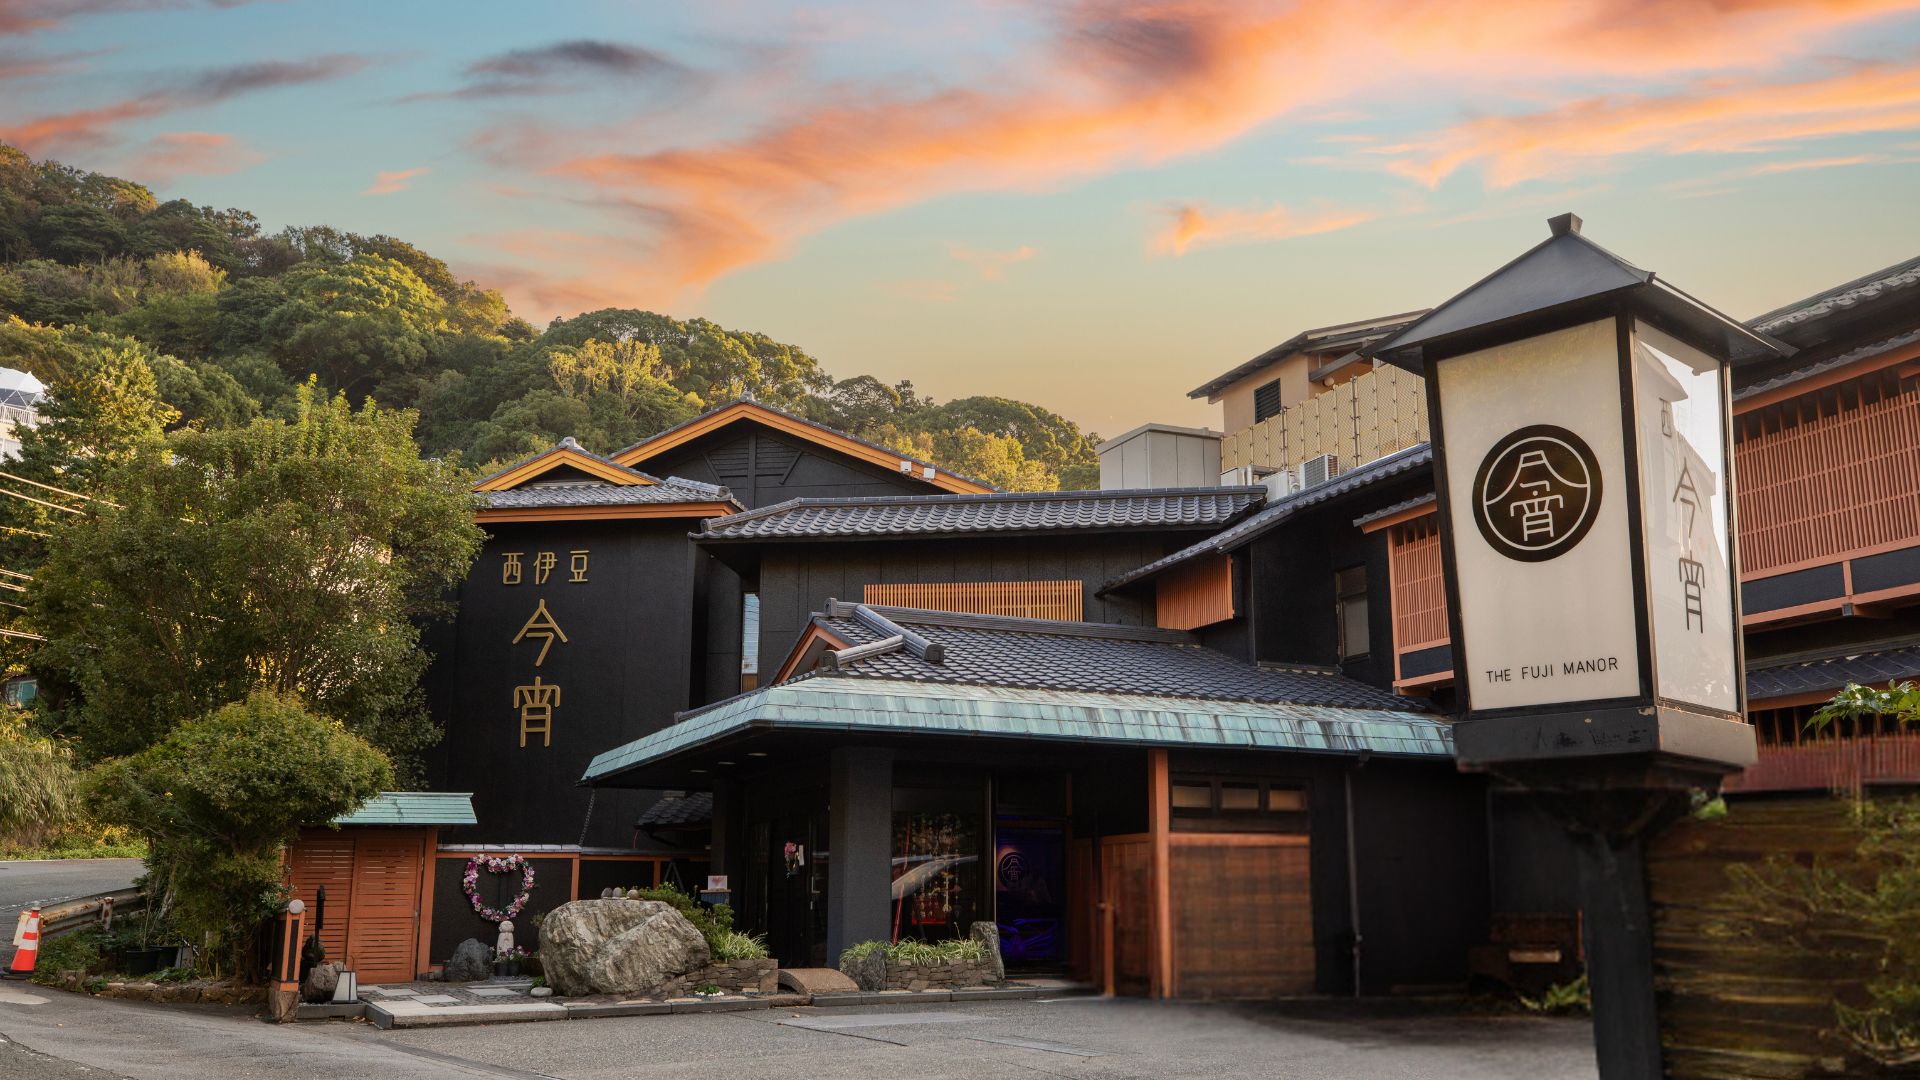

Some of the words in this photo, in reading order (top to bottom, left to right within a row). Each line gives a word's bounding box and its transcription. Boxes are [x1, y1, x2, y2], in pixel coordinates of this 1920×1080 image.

[502, 550, 590, 585] 西伊豆
[1672, 456, 1705, 634] 今宵
[512, 598, 568, 748] 今宵
[1486, 668, 1512, 683] THE
[1521, 664, 1554, 680] FUJI
[1563, 657, 1618, 675] MANOR
